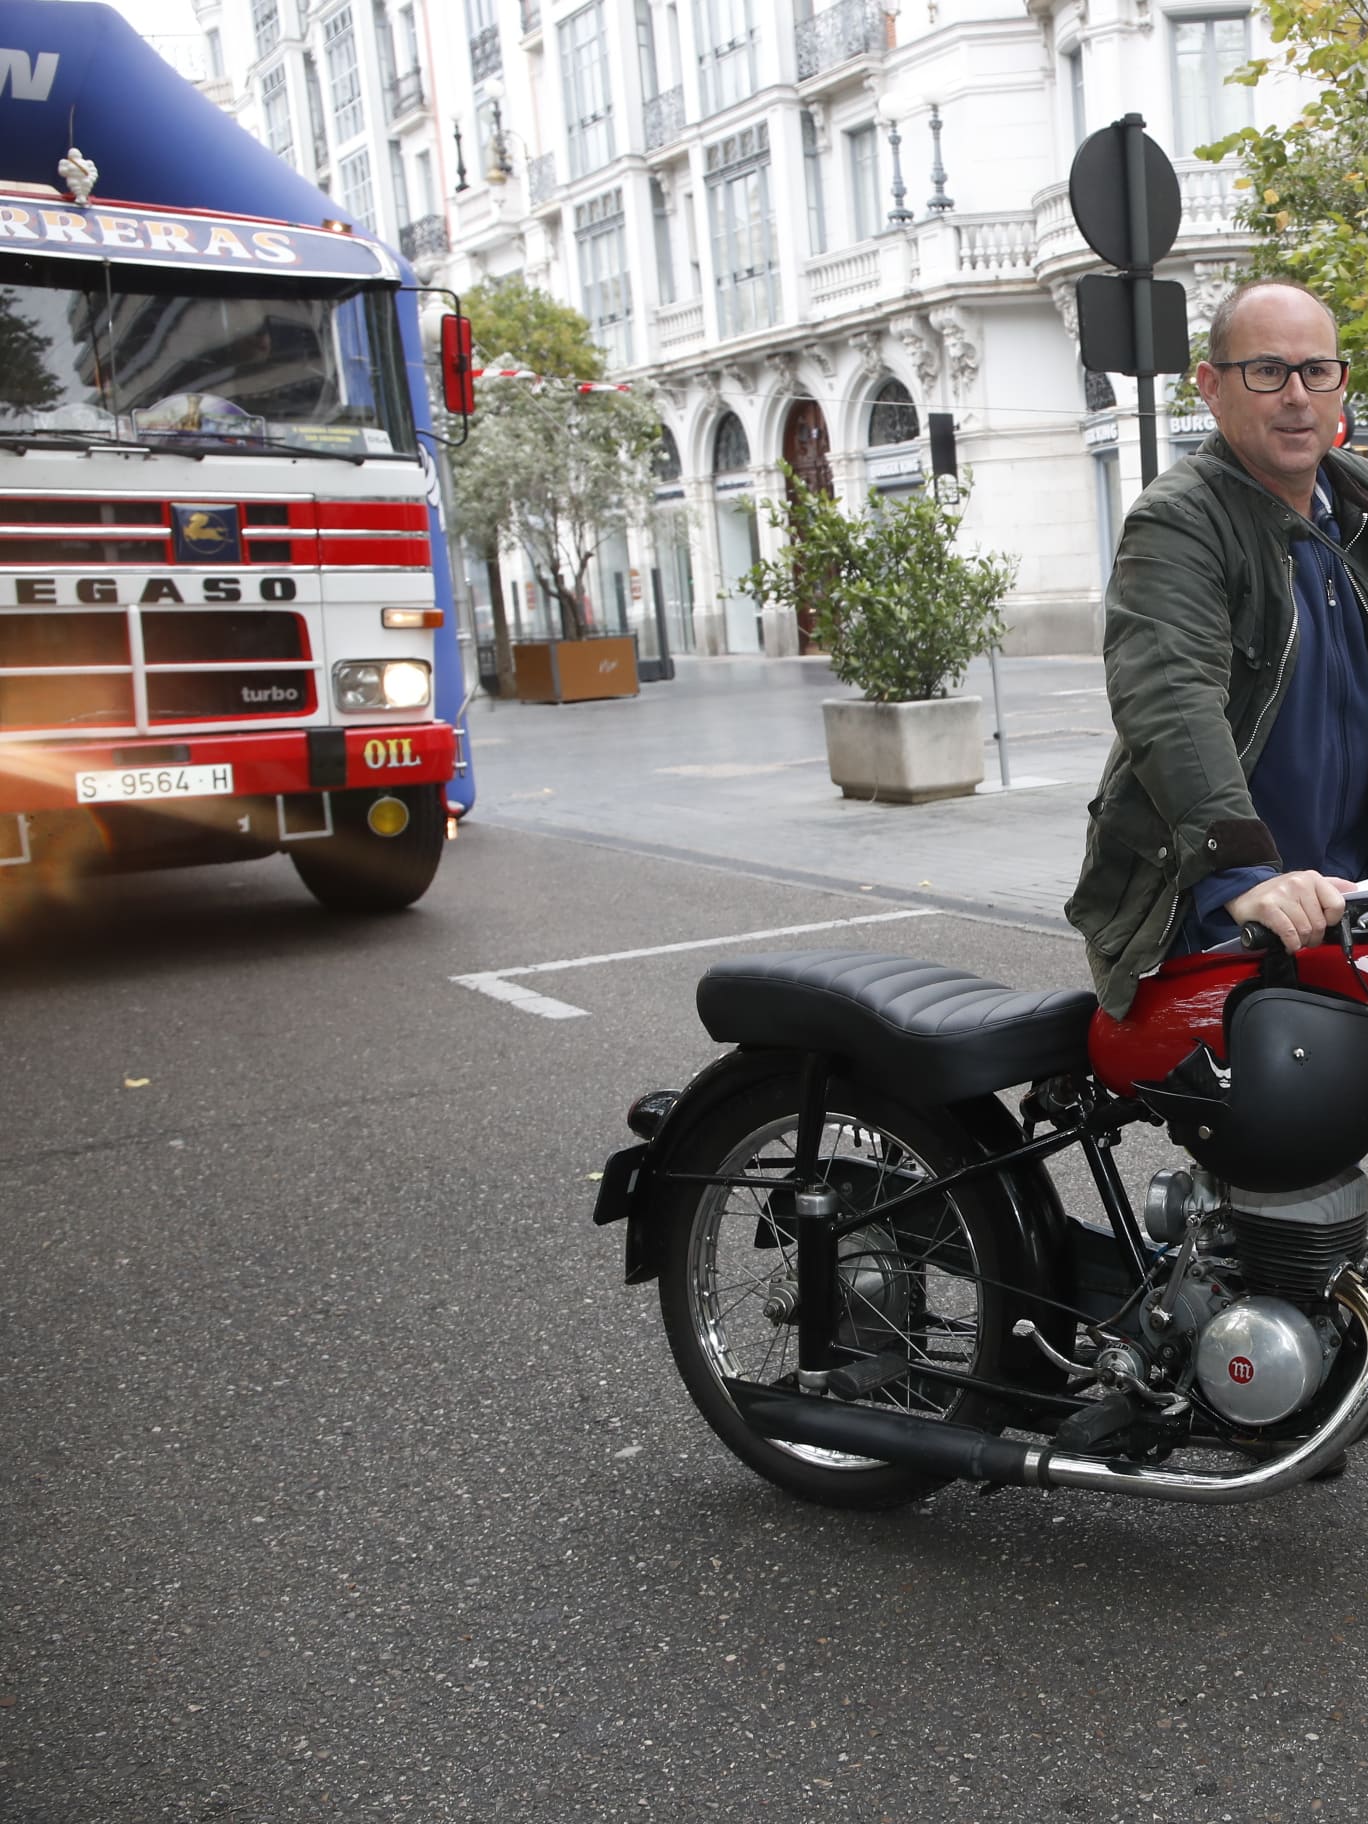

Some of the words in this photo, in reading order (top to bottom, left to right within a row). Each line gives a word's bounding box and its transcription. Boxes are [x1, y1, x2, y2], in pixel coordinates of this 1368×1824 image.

[15, 577, 297, 605] EGASO
[241, 685, 298, 702] turbo
[364, 738, 422, 769] OIL
[121, 770, 190, 796] 9564
